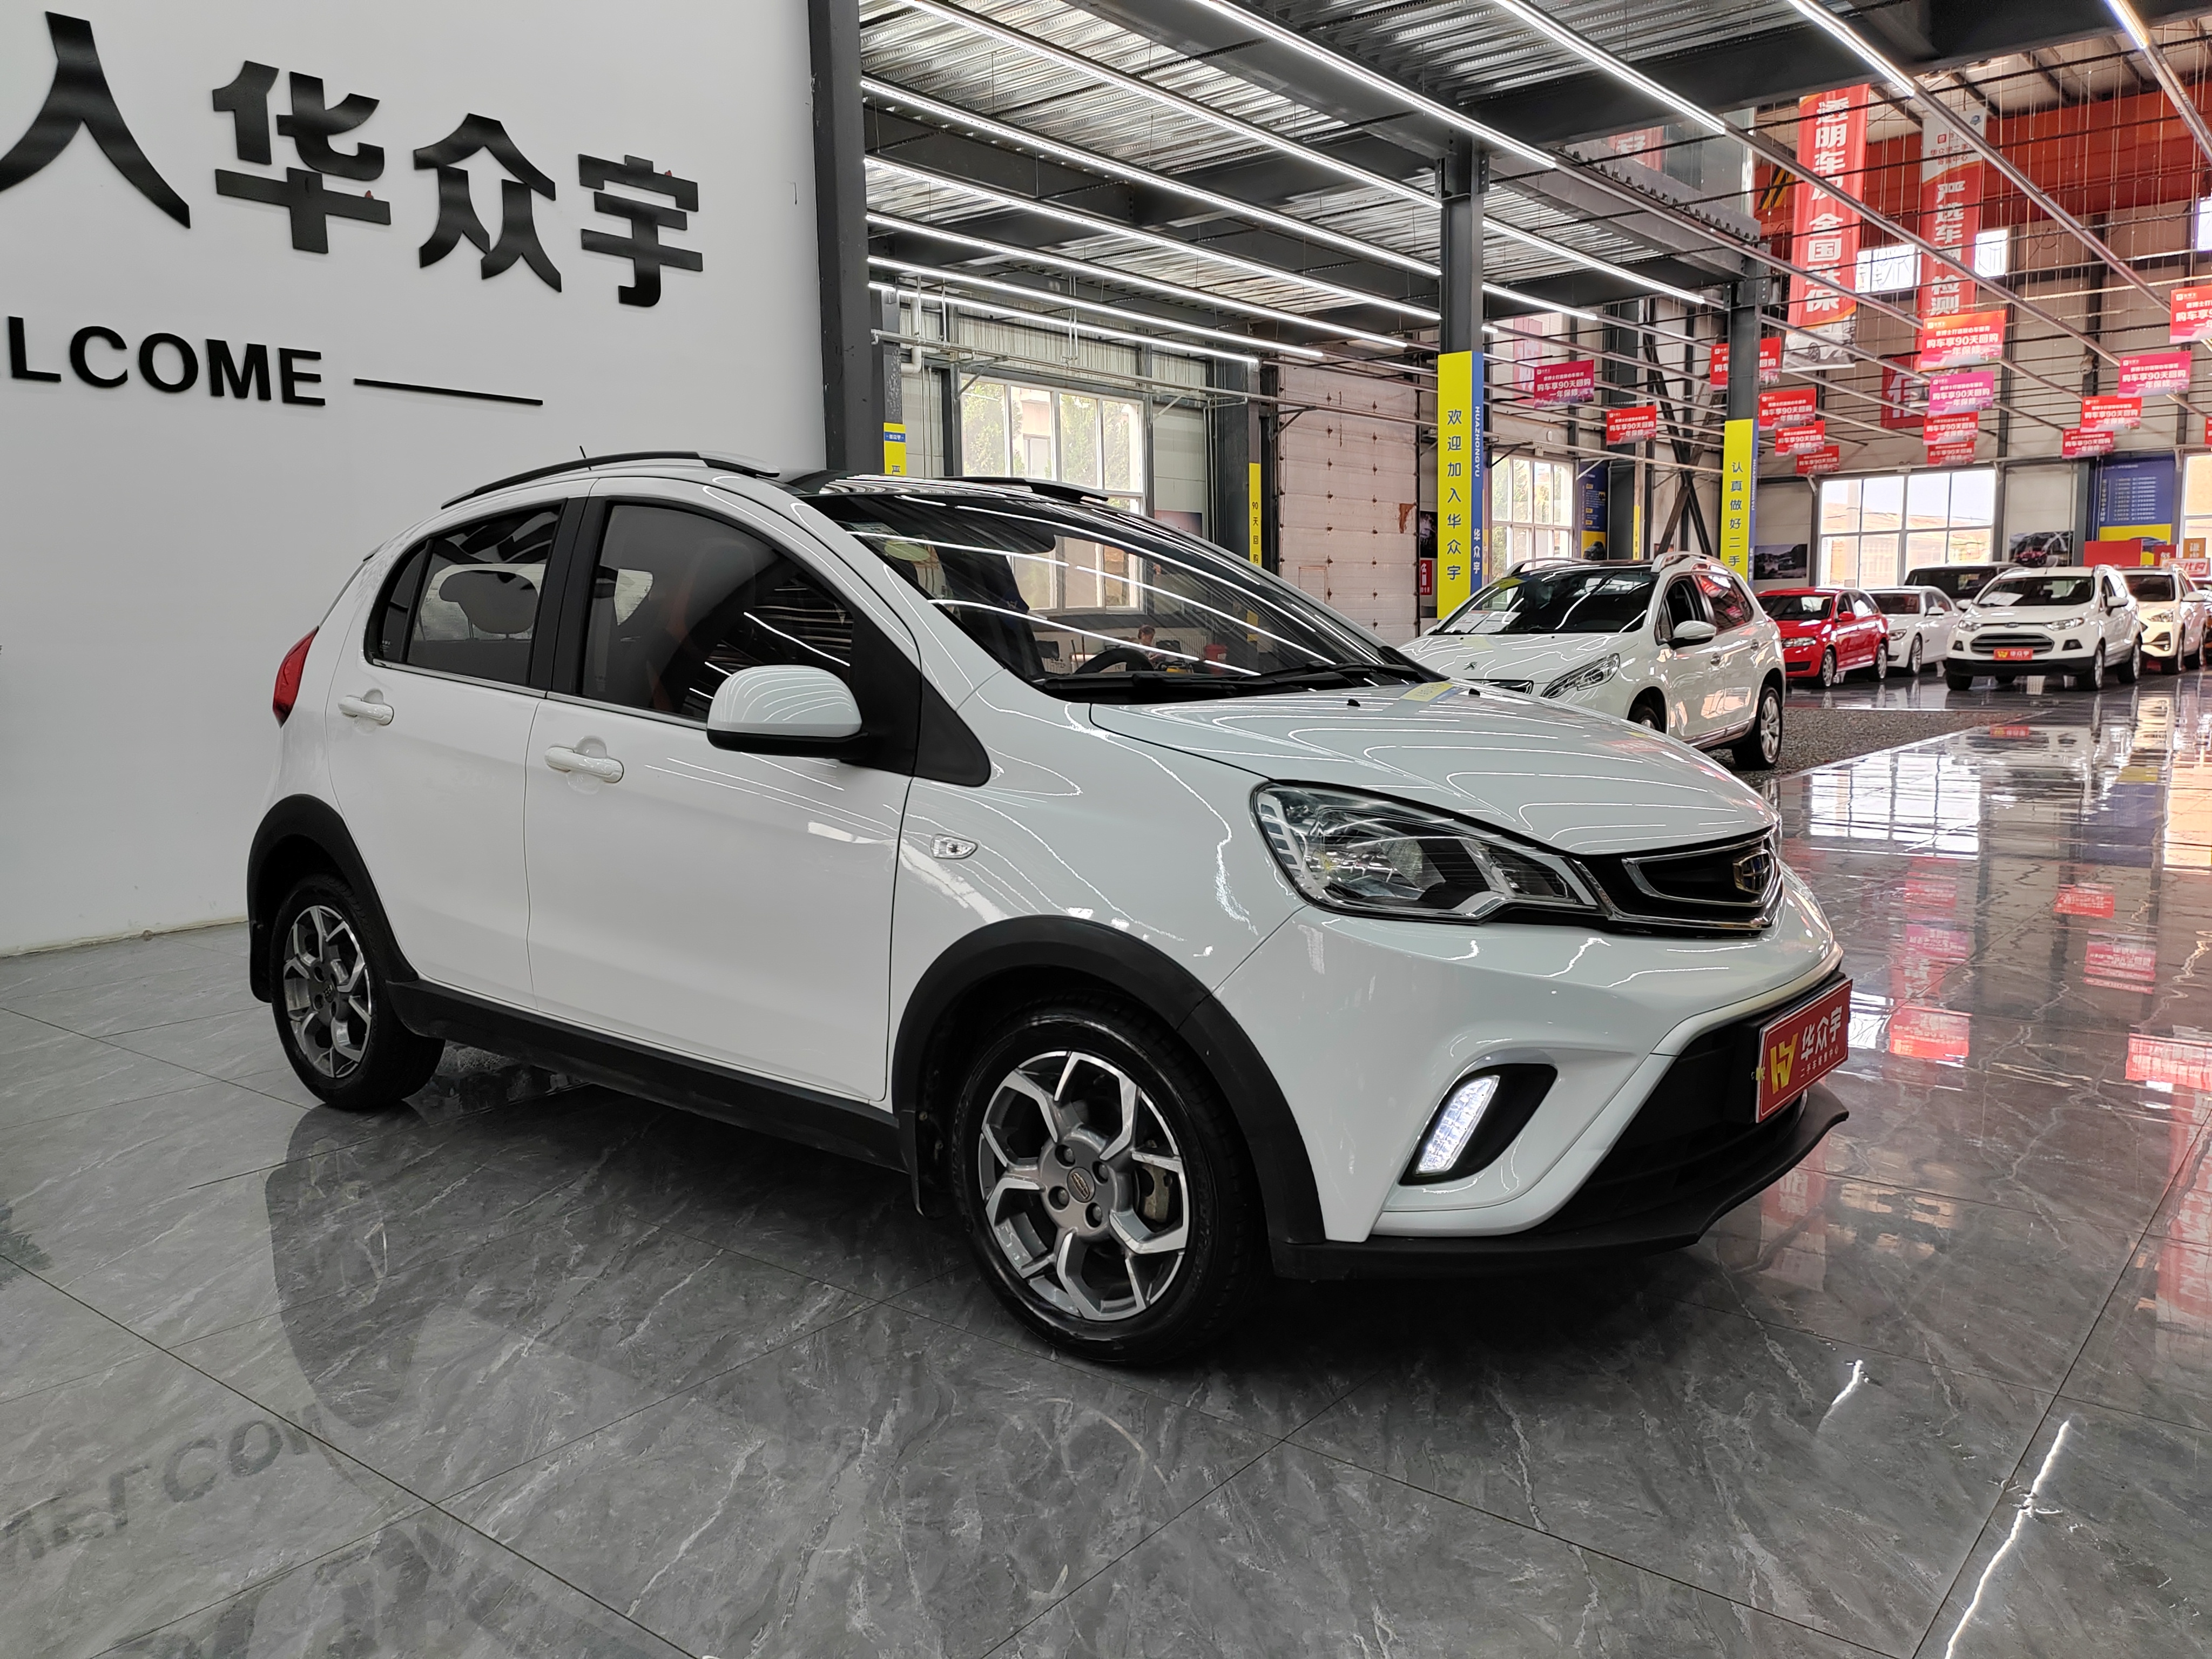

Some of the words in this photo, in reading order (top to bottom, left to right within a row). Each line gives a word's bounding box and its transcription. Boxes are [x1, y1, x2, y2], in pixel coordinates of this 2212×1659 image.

[1926, 333, 1999, 348] 购车享90天回购
[8, 316, 326, 406] LCOME
[2122, 370, 2186, 382] 购车享90天回购
[1537, 378, 1591, 392] 购车享90天回购
[1932, 388, 1990, 400] 购车享90天回购
[1609, 421, 1655, 431] 购车享90天回购
[1447, 409, 1462, 581] 欢迎加入华众宇
[1800, 1006, 1843, 1061] 华众宇
